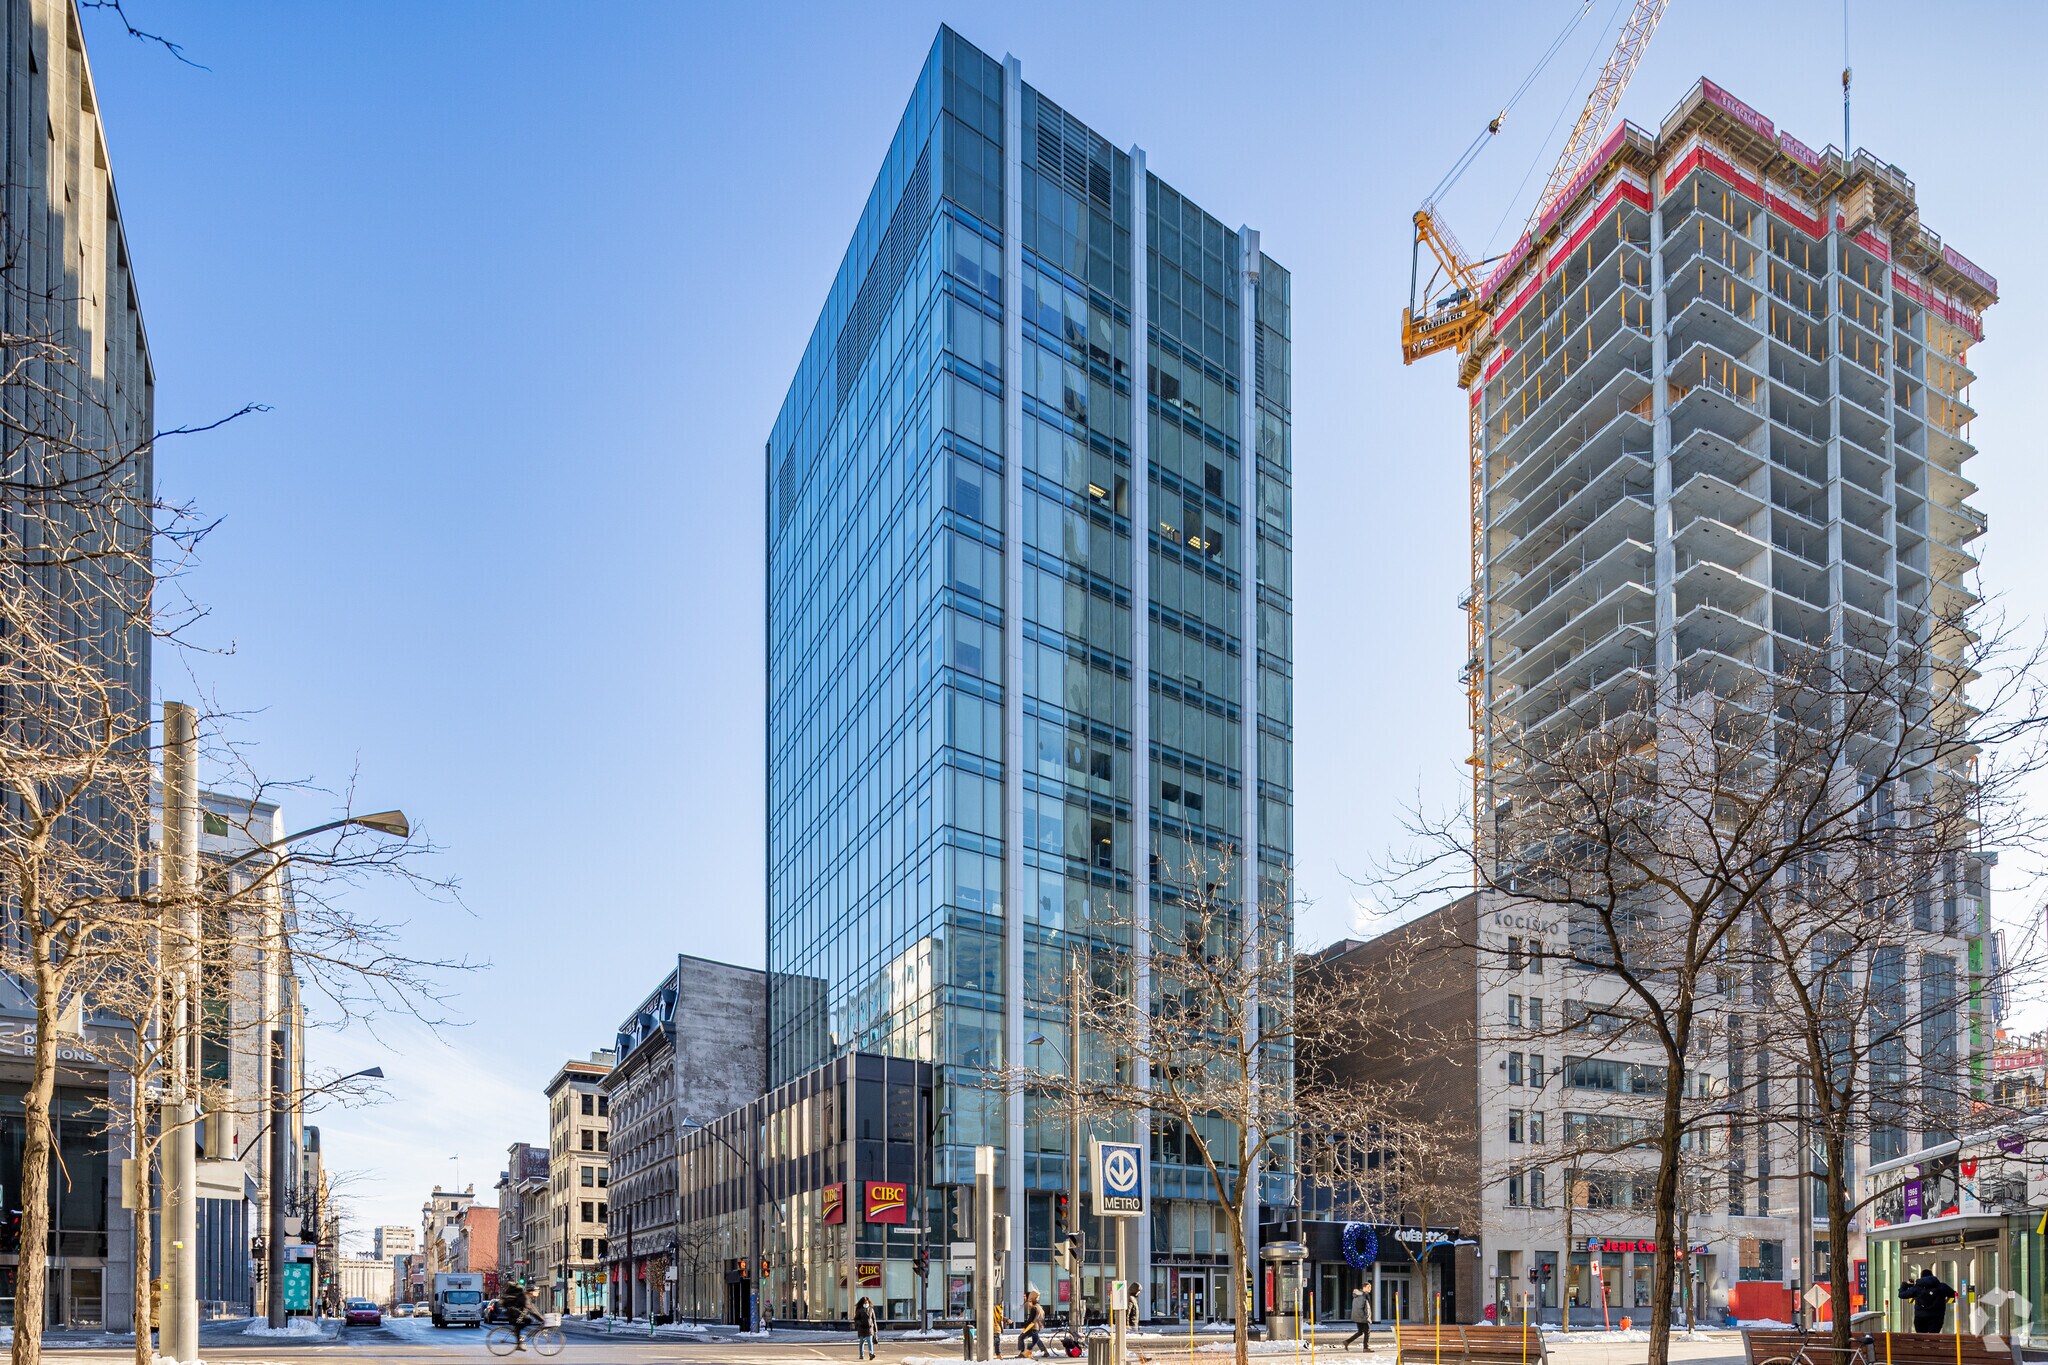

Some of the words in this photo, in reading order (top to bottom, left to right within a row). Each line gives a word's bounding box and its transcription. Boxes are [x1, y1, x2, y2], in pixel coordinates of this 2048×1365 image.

[1553, 152, 1603, 214] BROCCOLINI
[24, 1047, 95, 1062] RIONS
[823, 1188, 838, 1203] CIBC
[871, 1186, 904, 1202] CIBC
[1105, 1197, 1140, 1210] METRO
[1601, 1238, 1635, 1252] Jean
[859, 1265, 880, 1275] CIBC
